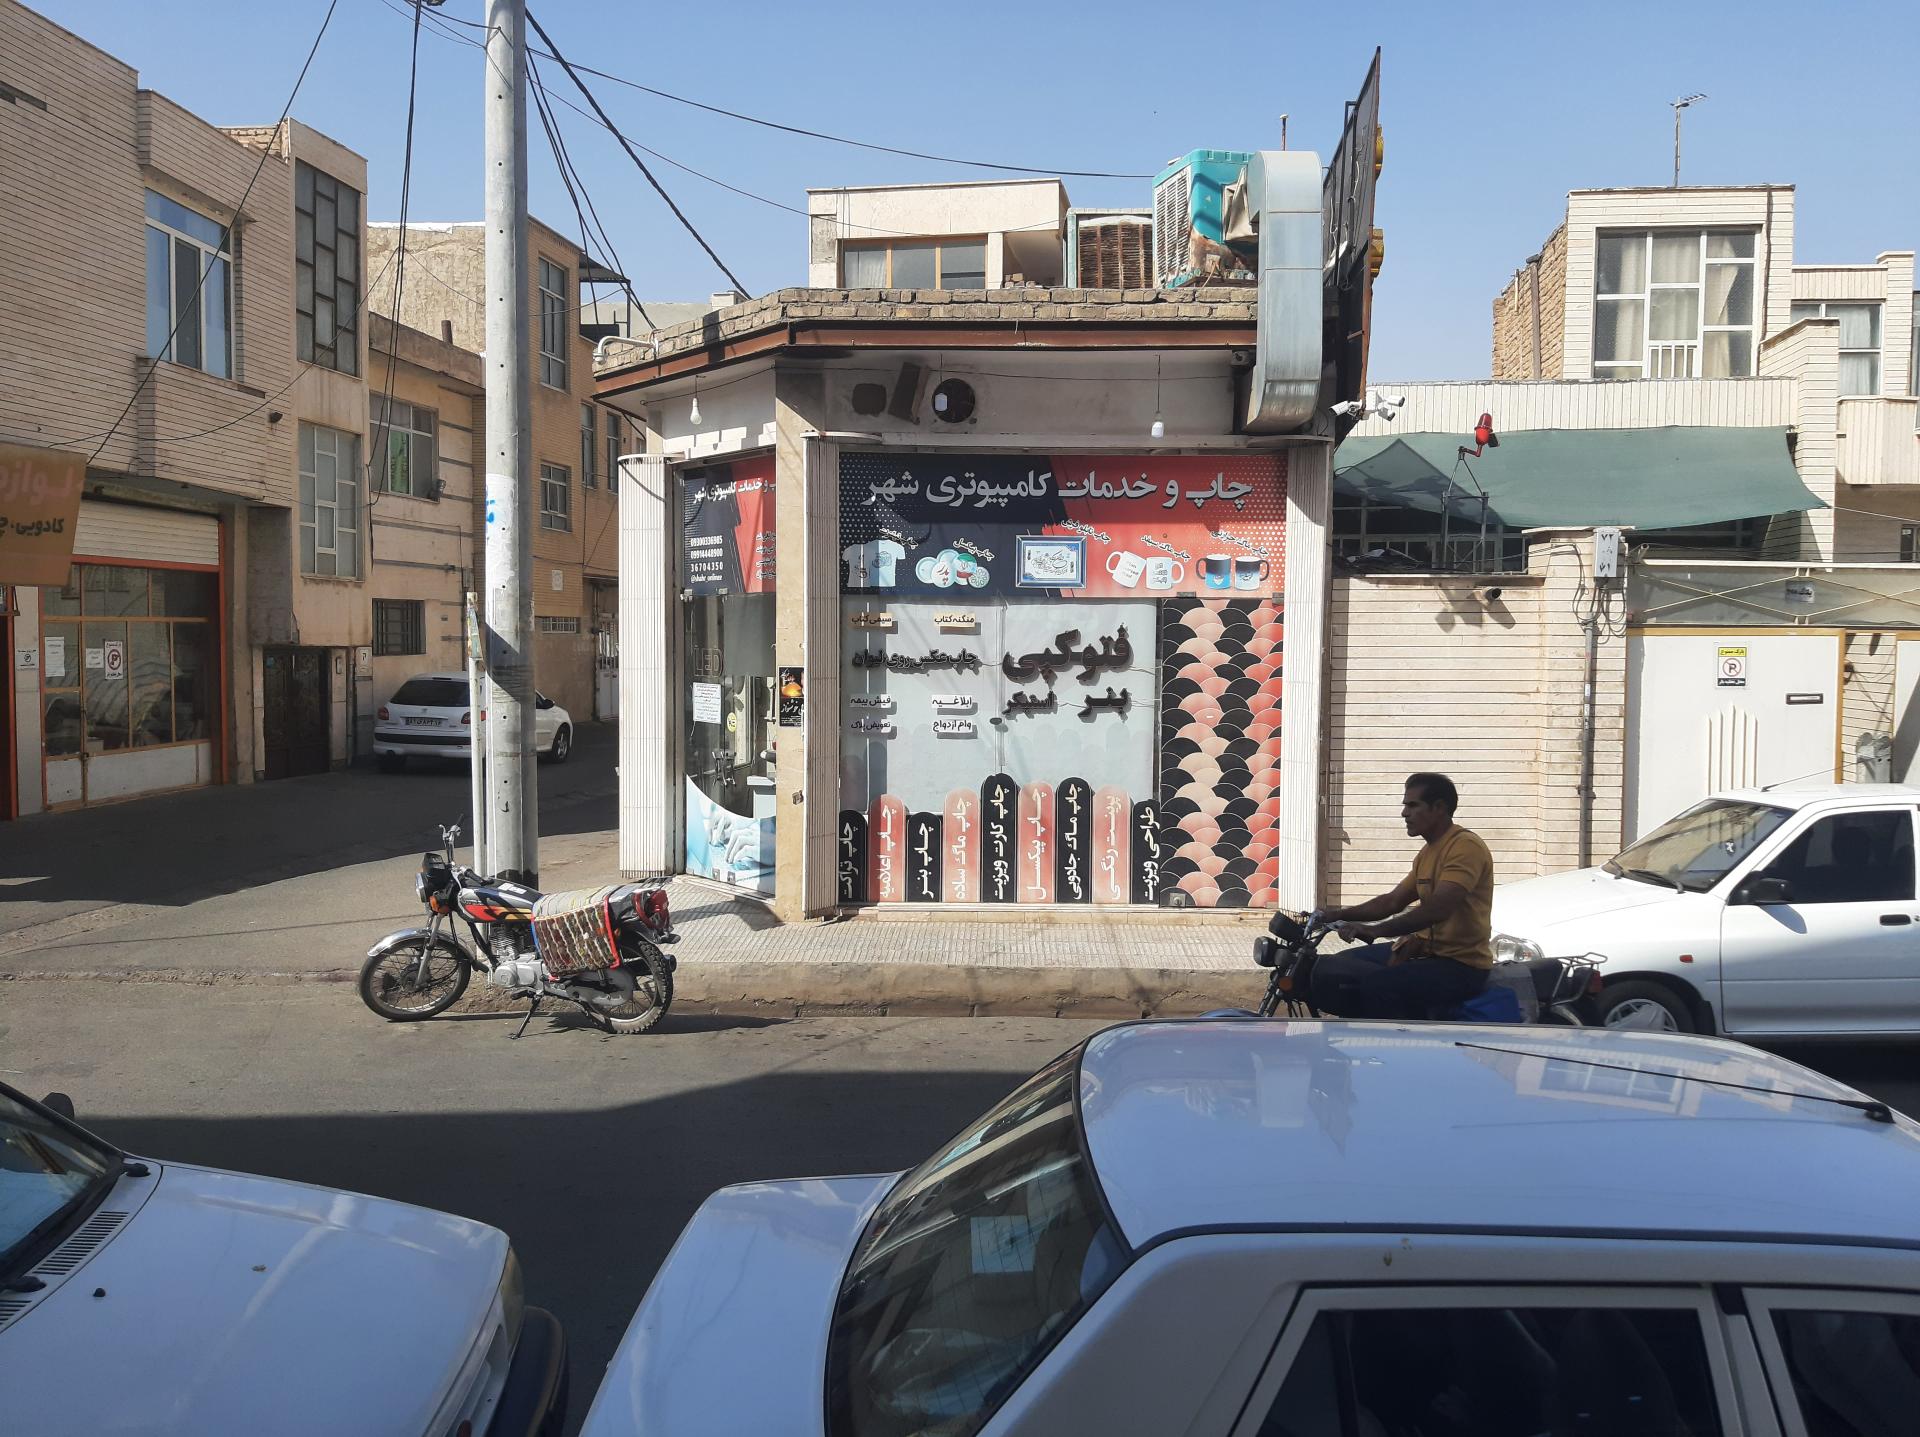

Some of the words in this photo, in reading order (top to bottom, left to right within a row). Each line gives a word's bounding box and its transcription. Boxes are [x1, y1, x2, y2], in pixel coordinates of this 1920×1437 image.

[707, 481, 737, 502] کامپیوتری
[737, 478, 762, 493] خدمات
[860, 471, 919, 506] شهر
[926, 470, 1052, 508] کامپیوتری
[1058, 471, 1158, 499] خدمات
[1162, 479, 1179, 508] و
[1186, 472, 1253, 510] چاپ
[690, 561, 724, 572] 36704350
[851, 614, 868, 623] کتاب
[934, 614, 953, 624] کتاب
[953, 614, 975, 624] منگنه
[886, 653, 912, 669] روی
[914, 648, 947, 669] عکس
[950, 648, 978, 669] چاپ
[1002, 624, 1132, 688] فتوکپی
[869, 696, 890, 707] فیش
[932, 696, 972, 708] ابلاغیه
[933, 719, 957, 733] ازدواج
[958, 720, 972, 732] وام
[952, 798, 971, 832] چاپ
[990, 784, 1010, 819] چاپ
[1027, 788, 1047, 837] چاپ
[1065, 783, 1083, 815] چاپ
[877, 805, 897, 851] چاپ
[1065, 817, 1077, 850] ماگ
[1105, 795, 1122, 847] پرینت
[1139, 806, 1160, 859] طراحی
[839, 822, 859, 858] چاپ
[914, 822, 934, 866] چاپ
[952, 834, 966, 865] ماگ
[990, 822, 1008, 857] کارت
[839, 860, 859, 899] تراکت
[876, 854, 896, 898] اعلامیه
[916, 868, 934, 899] بنر
[951, 868, 967, 900] ساده
[992, 859, 1010, 899] ویزیت
[1027, 839, 1047, 900] پیکسل
[1064, 852, 1083, 900] جادویی
[1100, 848, 1121, 900] رنگی
[1142, 860, 1160, 901] ویزیت
